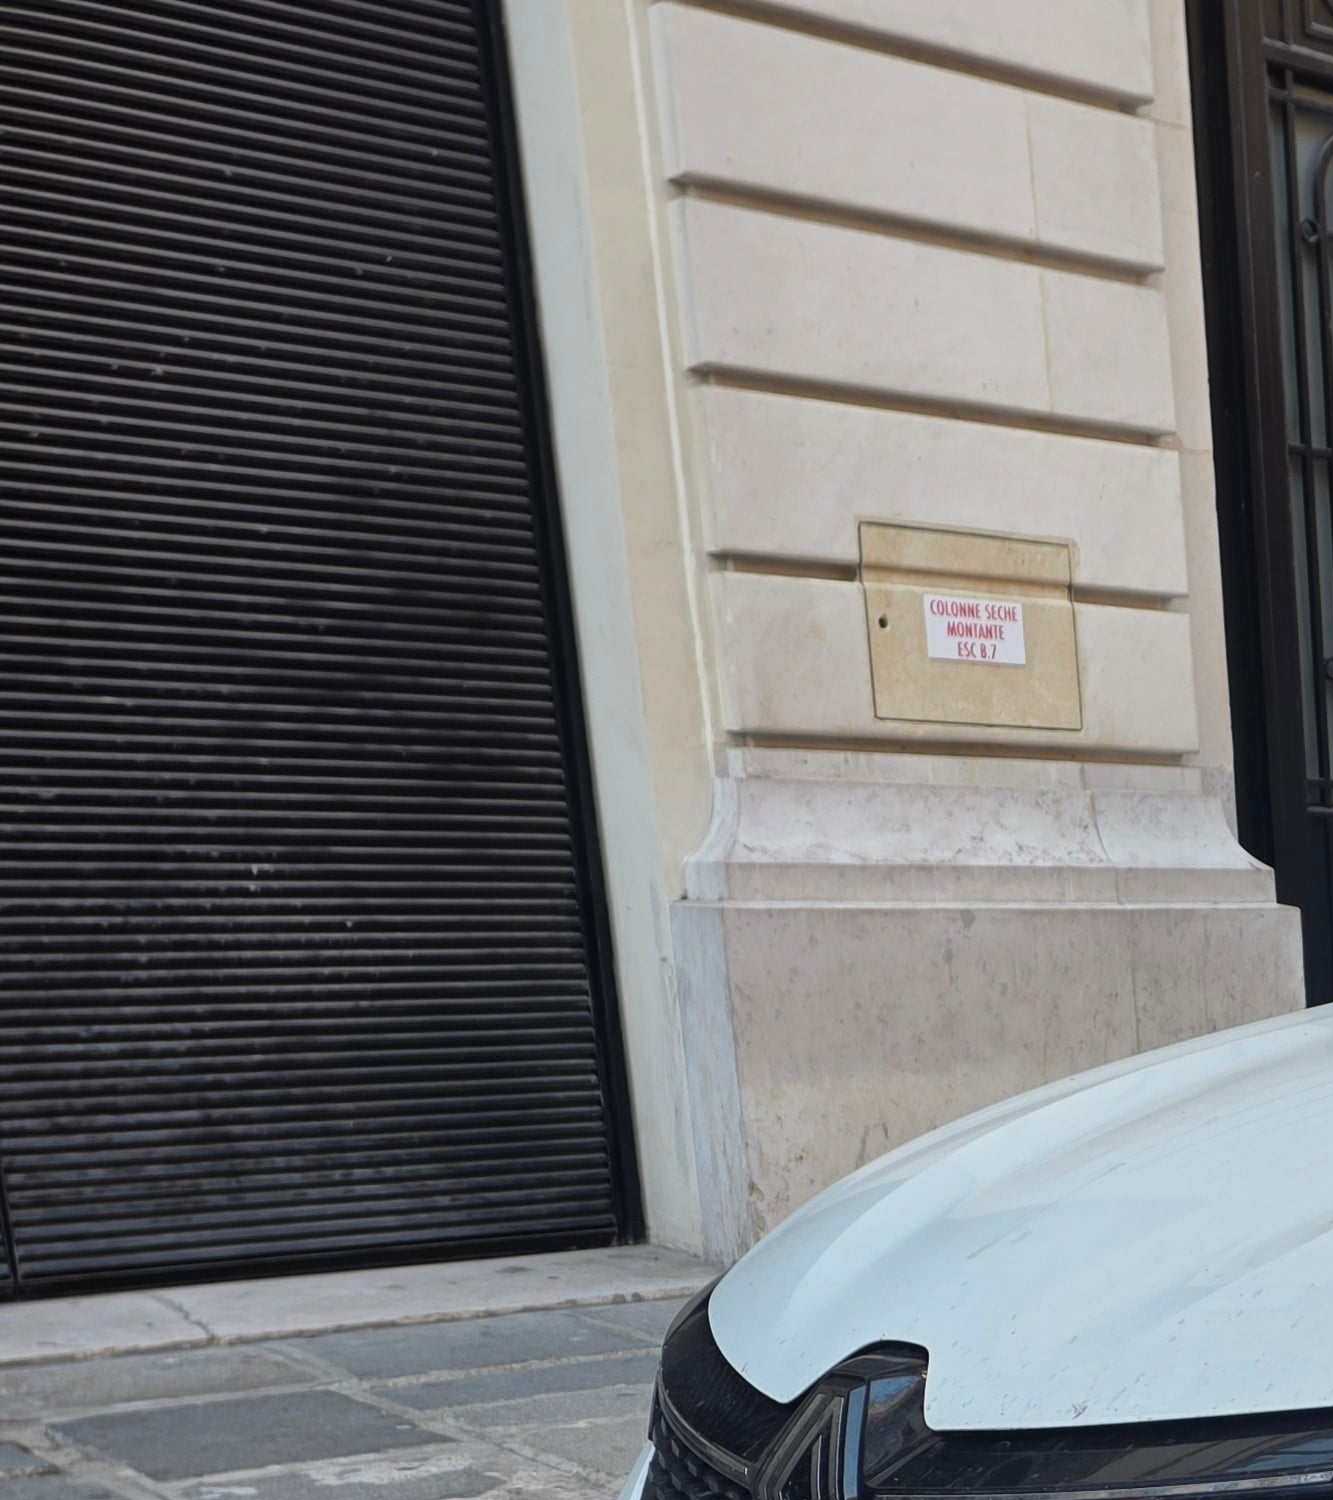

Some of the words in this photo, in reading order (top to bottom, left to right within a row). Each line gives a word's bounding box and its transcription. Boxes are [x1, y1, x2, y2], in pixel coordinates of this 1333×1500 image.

[930, 599, 981, 619] COLONNE
[984, 603, 1018, 622] SECHE
[947, 621, 1005, 641] MONTANTE
[957, 641, 977, 659] ESC
[980, 643, 997, 660] B.7
